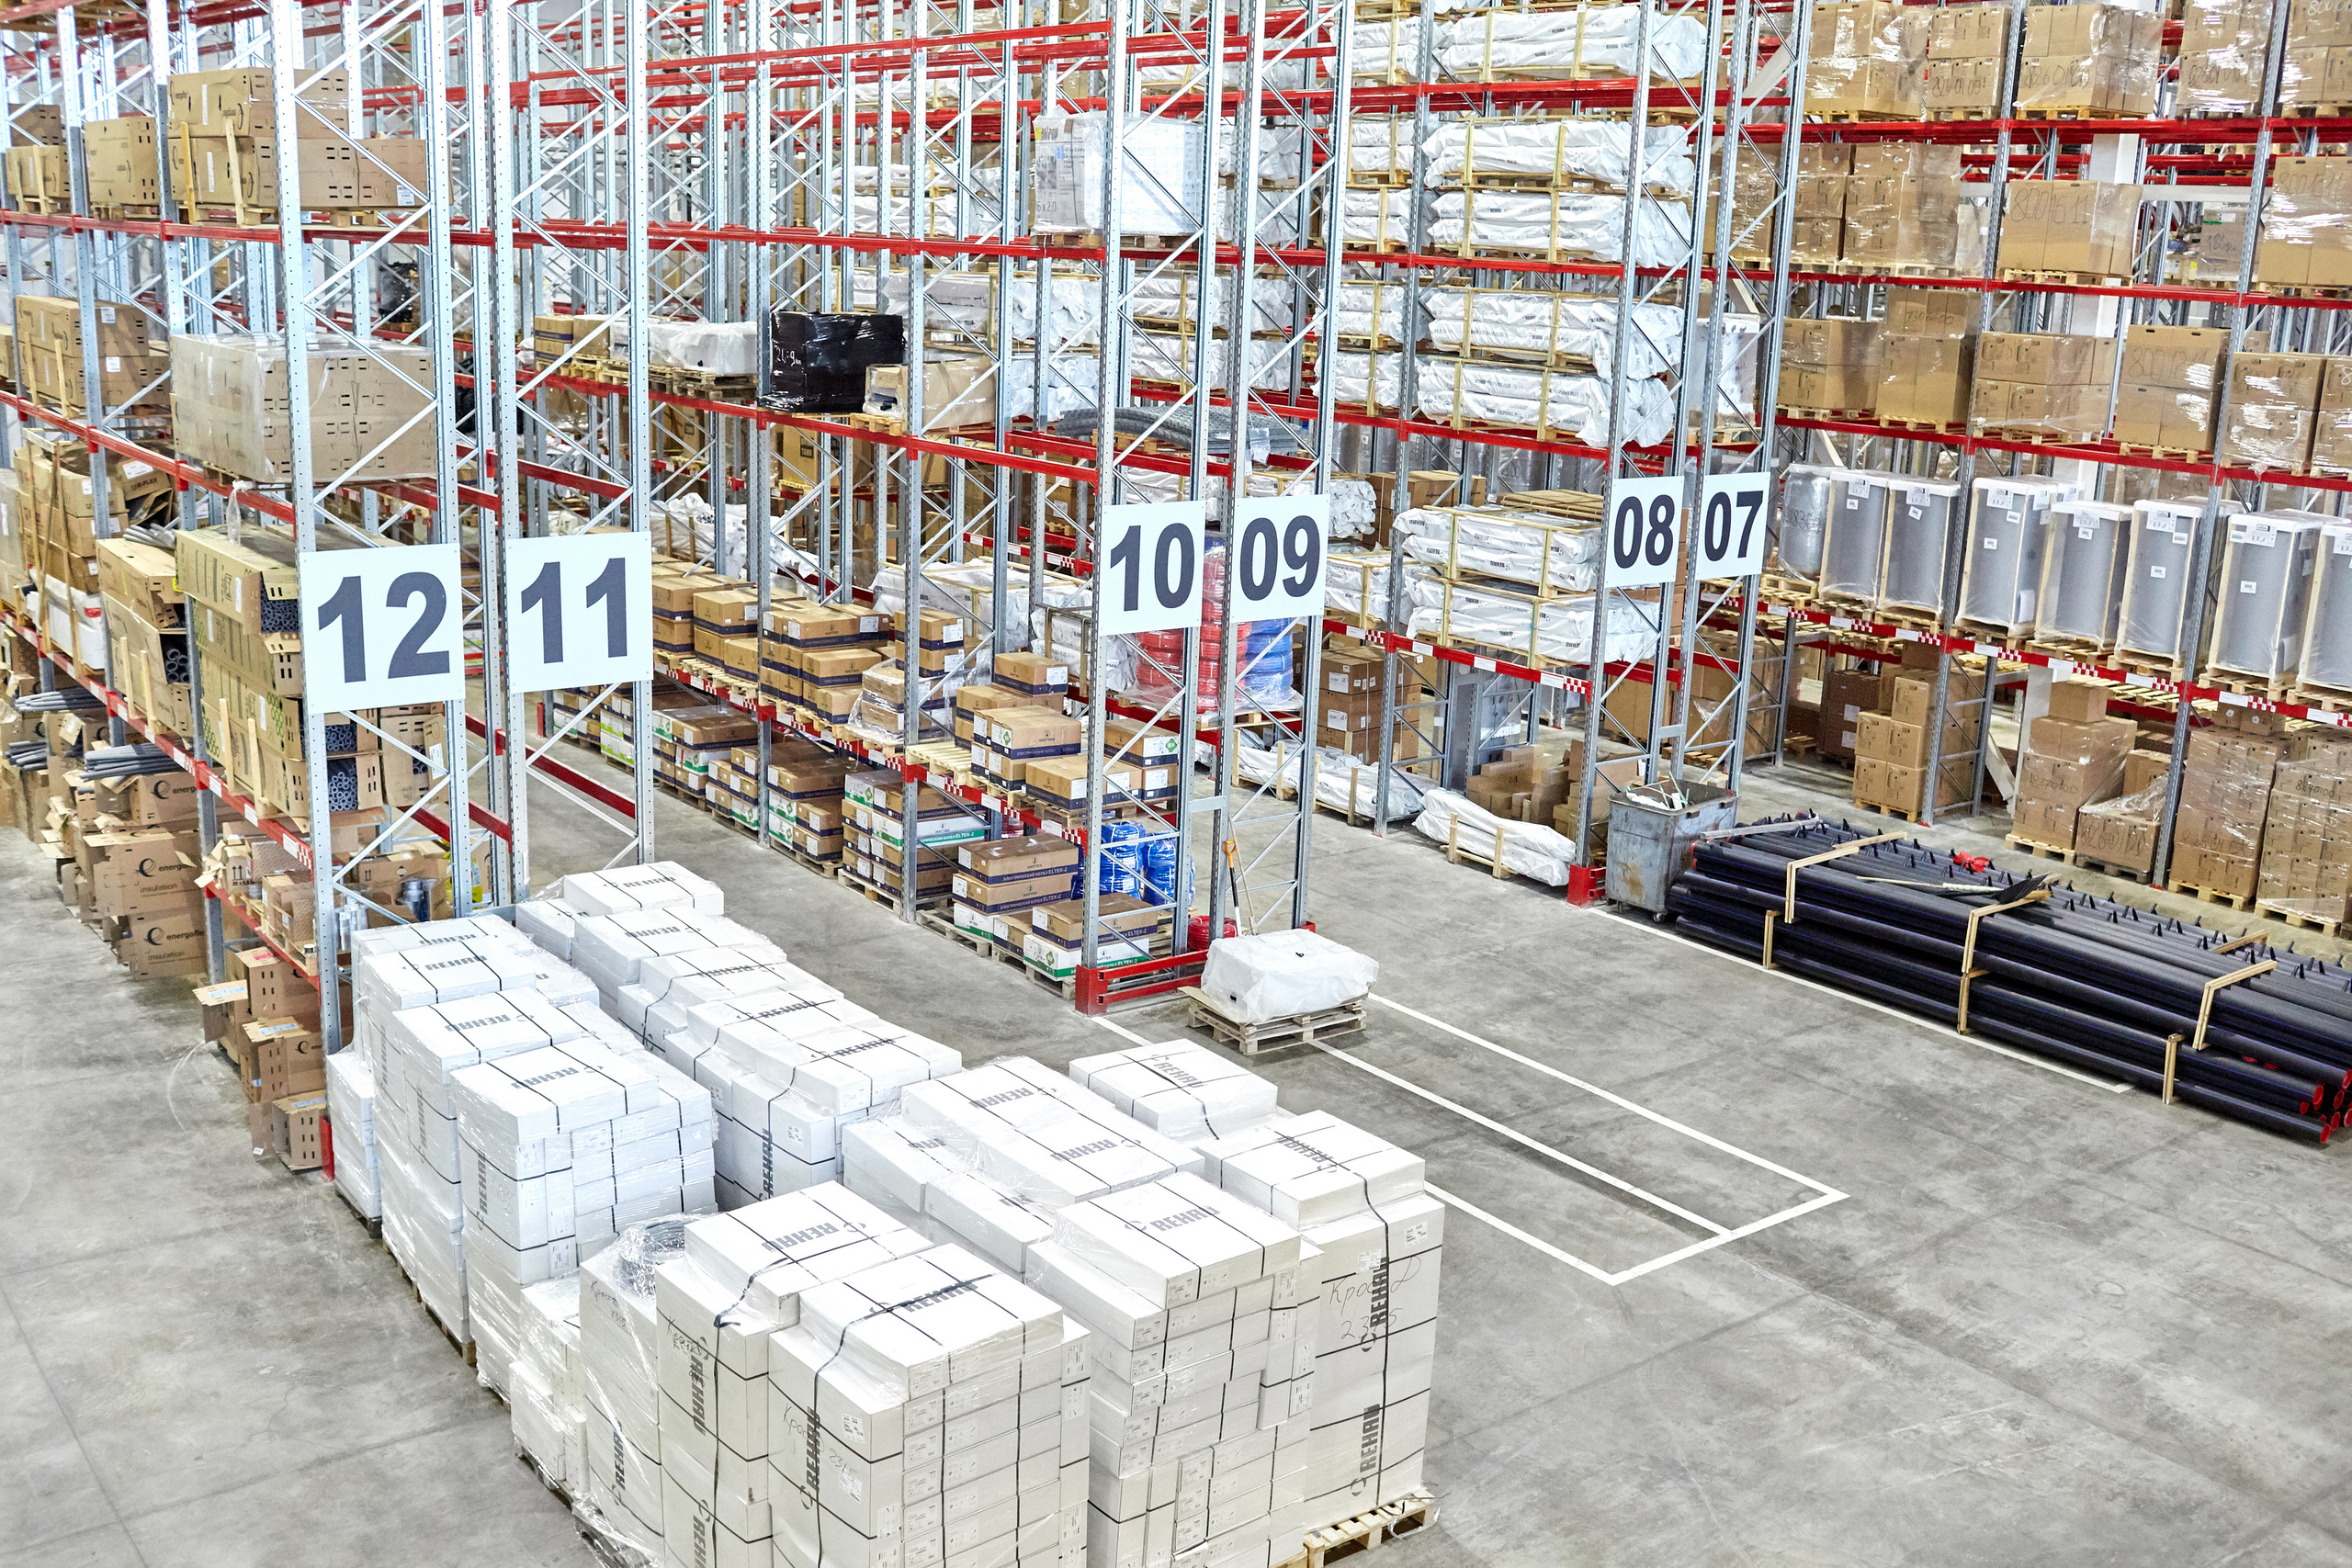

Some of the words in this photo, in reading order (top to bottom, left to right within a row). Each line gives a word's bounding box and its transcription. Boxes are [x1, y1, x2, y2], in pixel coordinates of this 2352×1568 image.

[1614, 495, 1675, 569] 08
[1705, 491, 1763, 561] 07
[1111, 524, 1194, 611] 10
[1240, 515, 1320, 601] 09
[522, 558, 627, 663] 11
[318, 572, 449, 682] 12
[141, 883, 177, 893] insulation
[622, 876, 676, 888] REHAU
[167, 930, 205, 940] energofle
[625, 926, 680, 938] REHAU
[1128, 929, 1147, 937] ELTEK-2
[148, 951, 185, 961] insulation
[425, 955, 487, 971] REHAU
[445, 1014, 511, 1032] REHAU
[510, 1067, 579, 1089] REHAU
[1154, 1062, 1206, 1089] REHAU
[967, 1088, 1035, 1109] REHAU
[761, 1128, 774, 1196] REHAU
[1049, 1139, 1118, 1163] REHAU
[1150, 1206, 1221, 1231] REHAU
[760, 1223, 840, 1252] REHAU
[807, 1406, 820, 1494] REHAU
[1359, 1405, 1380, 1473] REHAU
